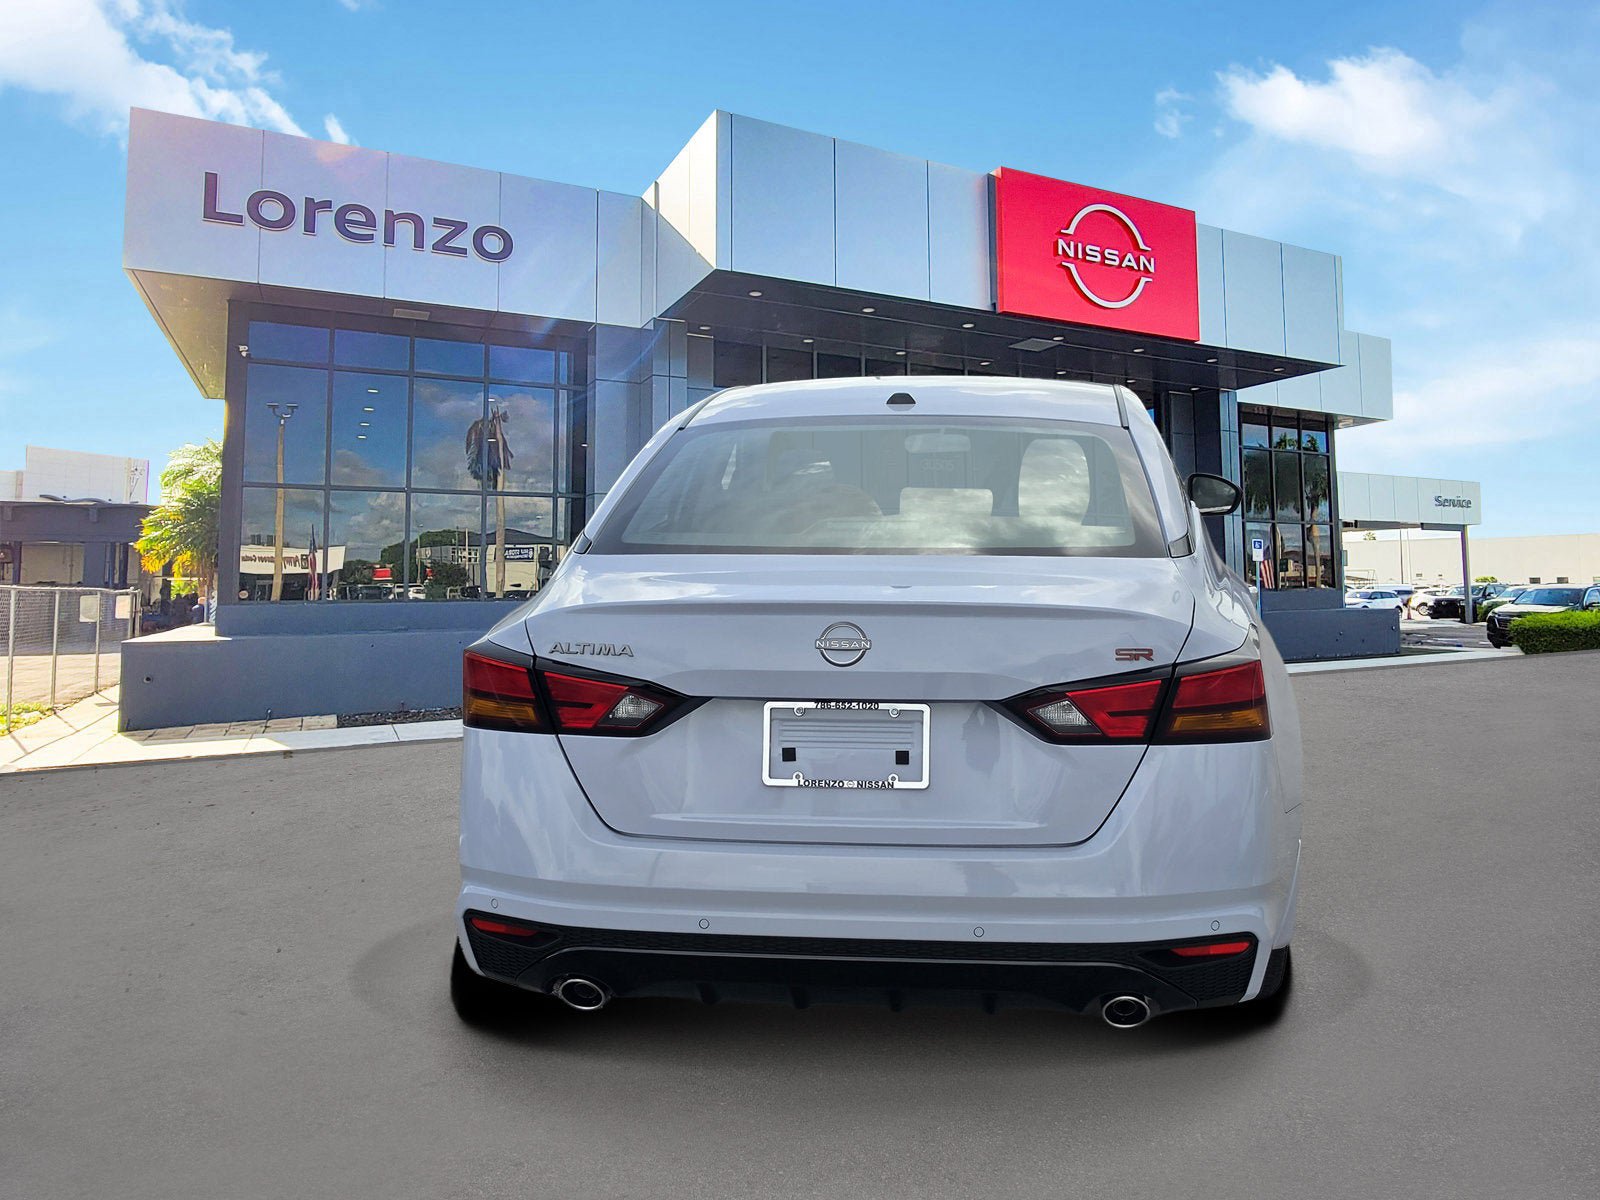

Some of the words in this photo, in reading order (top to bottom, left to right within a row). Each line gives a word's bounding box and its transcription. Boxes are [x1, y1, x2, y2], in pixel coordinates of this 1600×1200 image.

[202, 171, 514, 262] Lorenzo
[1057, 238, 1155, 273] NISSAN
[1434, 495, 1472, 509] Service
[549, 642, 634, 657] ALTIMA
[816, 640, 871, 649] NISSAN
[1115, 648, 1154, 661] SR
[815, 701, 879, 710] 786-652-1020
[798, 779, 845, 788] LORENZO
[856, 780, 894, 789] NISSAN
